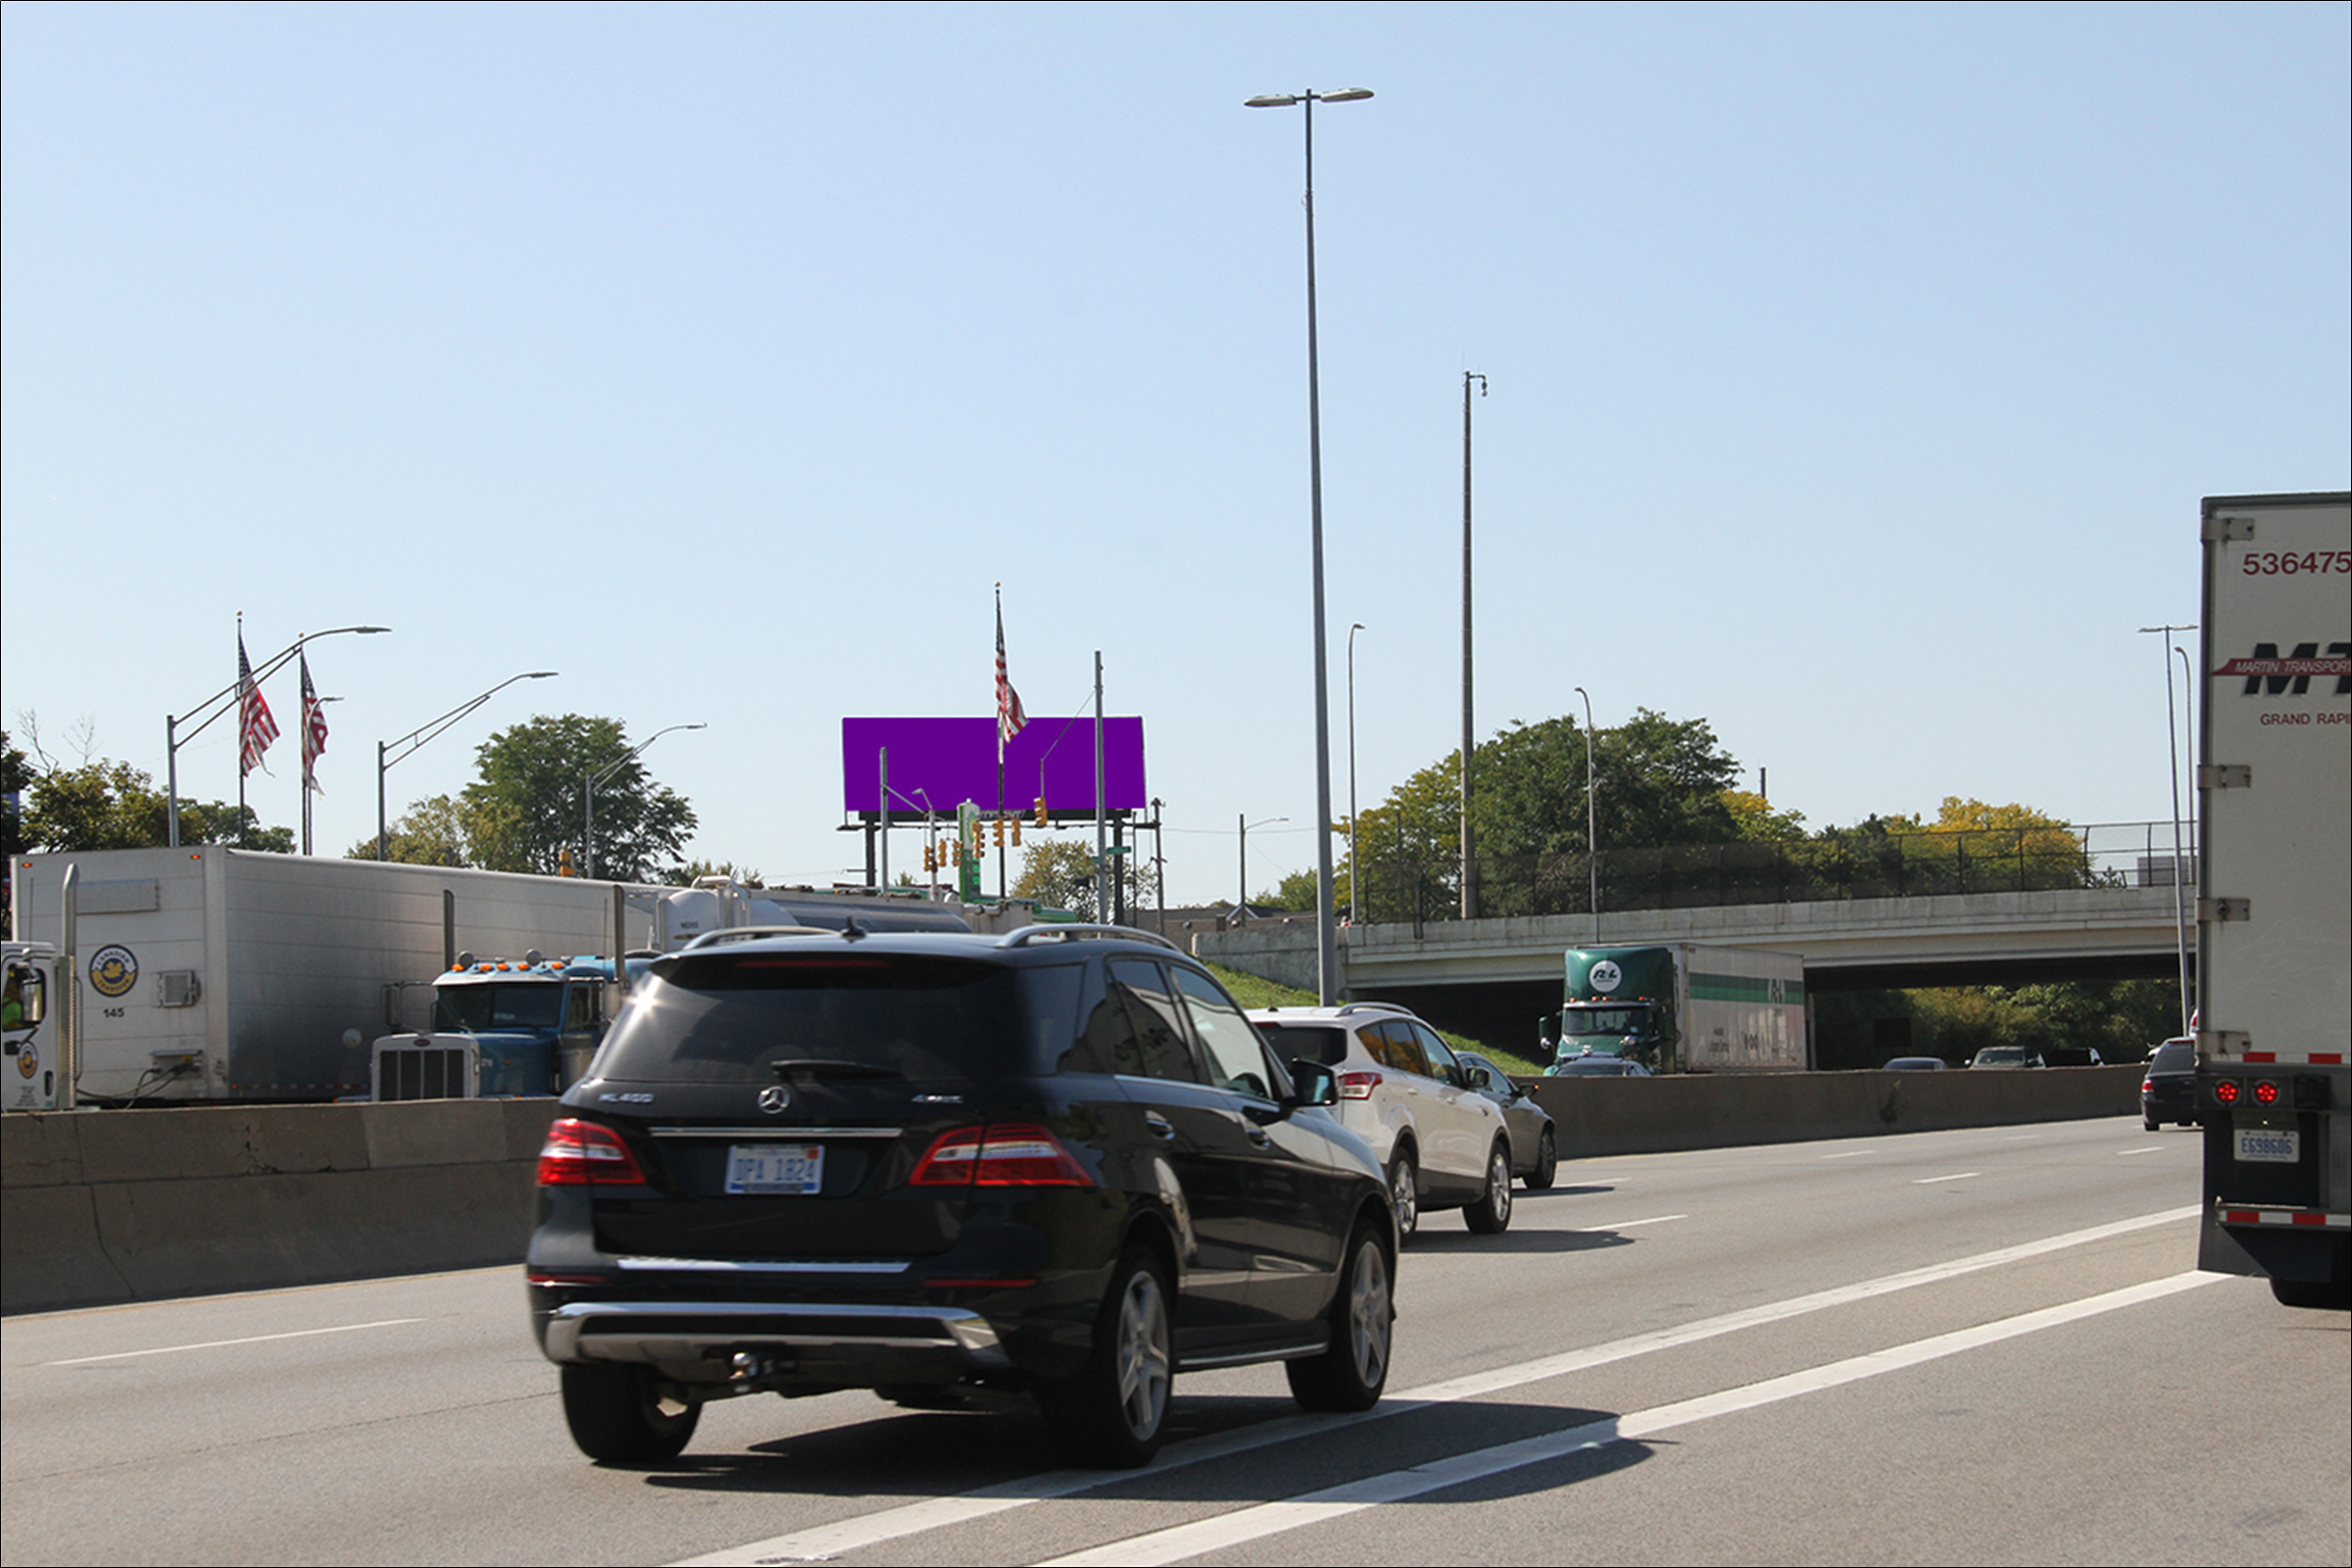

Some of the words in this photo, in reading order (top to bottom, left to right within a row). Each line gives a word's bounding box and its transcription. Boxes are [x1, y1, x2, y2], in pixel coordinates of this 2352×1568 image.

[2242, 552, 2351, 575] 536475
[2234, 661, 2279, 673] MARTIN
[2260, 713, 2311, 726] GRAND
[103, 1007, 125, 1018] 145
